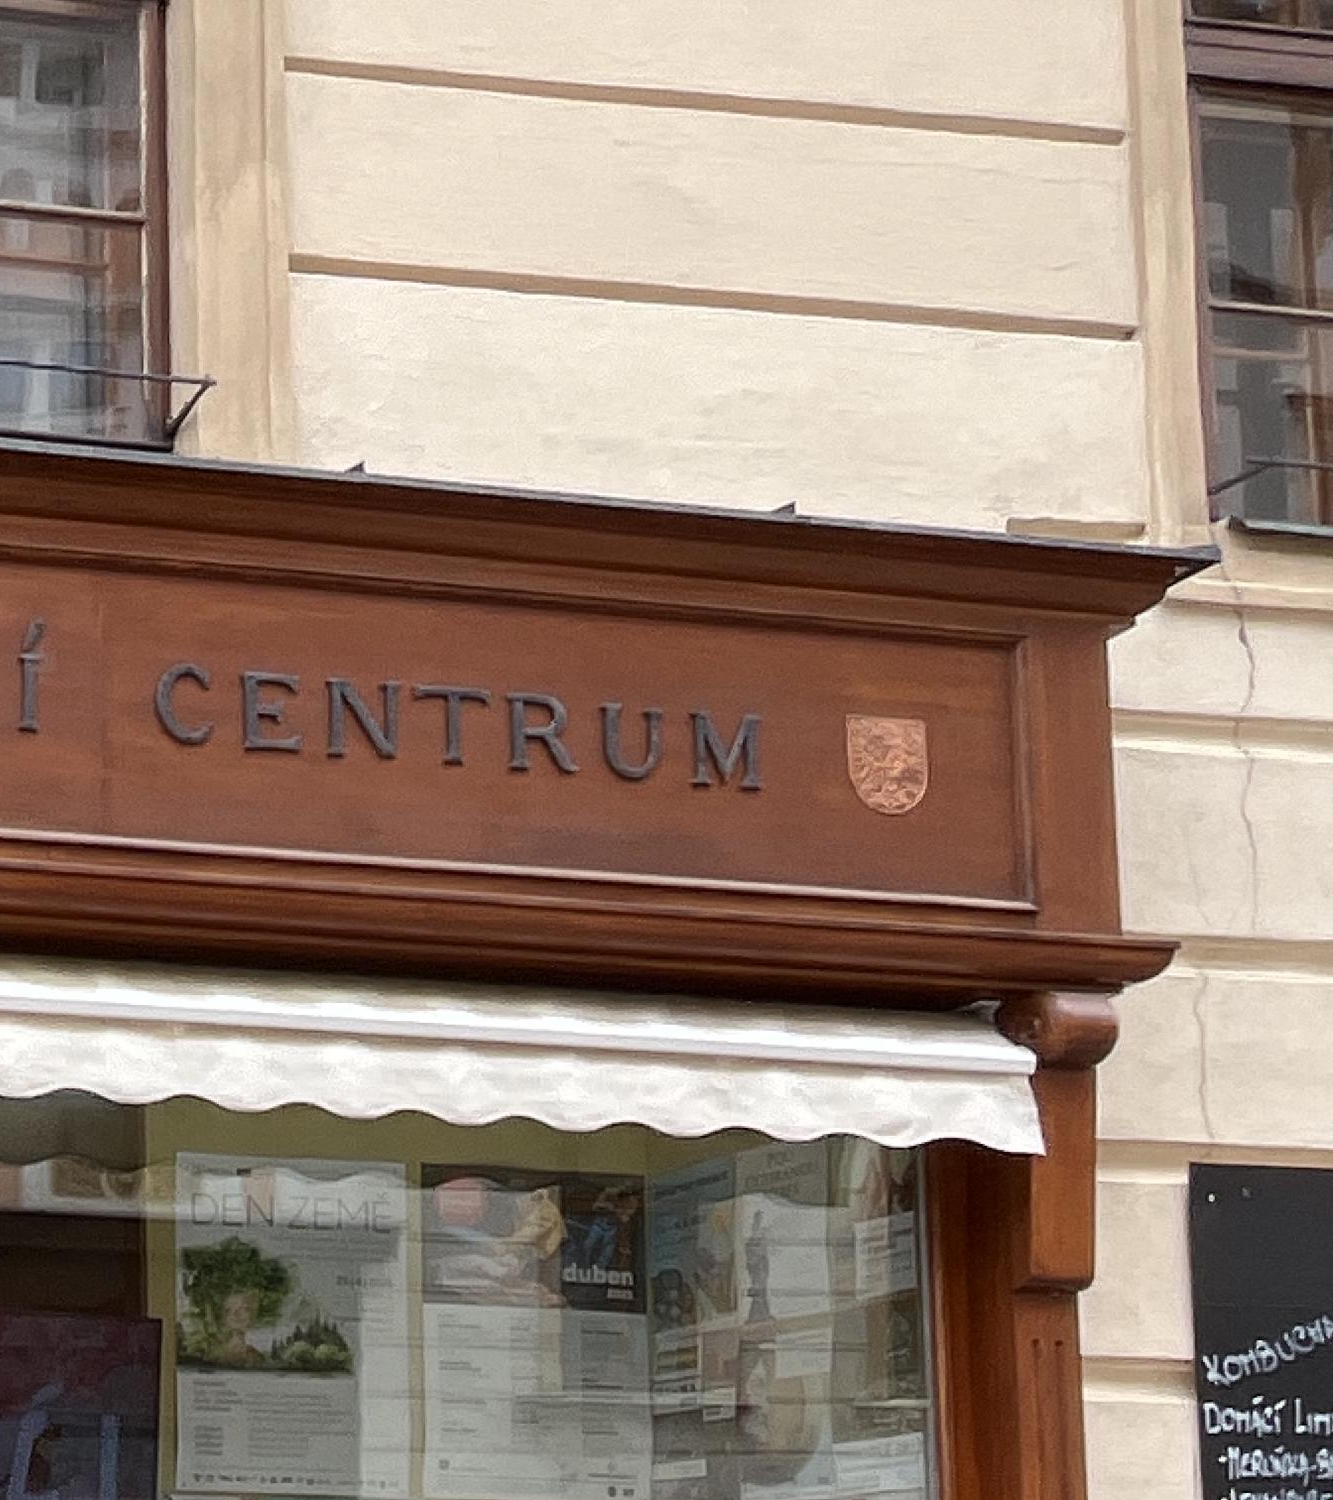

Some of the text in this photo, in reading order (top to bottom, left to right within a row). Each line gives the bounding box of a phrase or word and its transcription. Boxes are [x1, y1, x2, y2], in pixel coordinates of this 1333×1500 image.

[153, 662, 764, 791] CENTRUM
[190, 1190, 392, 1233] DEN ZEMĚ
[562, 1261, 634, 1287] duben
[1294, 1397, 1333, 1437] LIM
